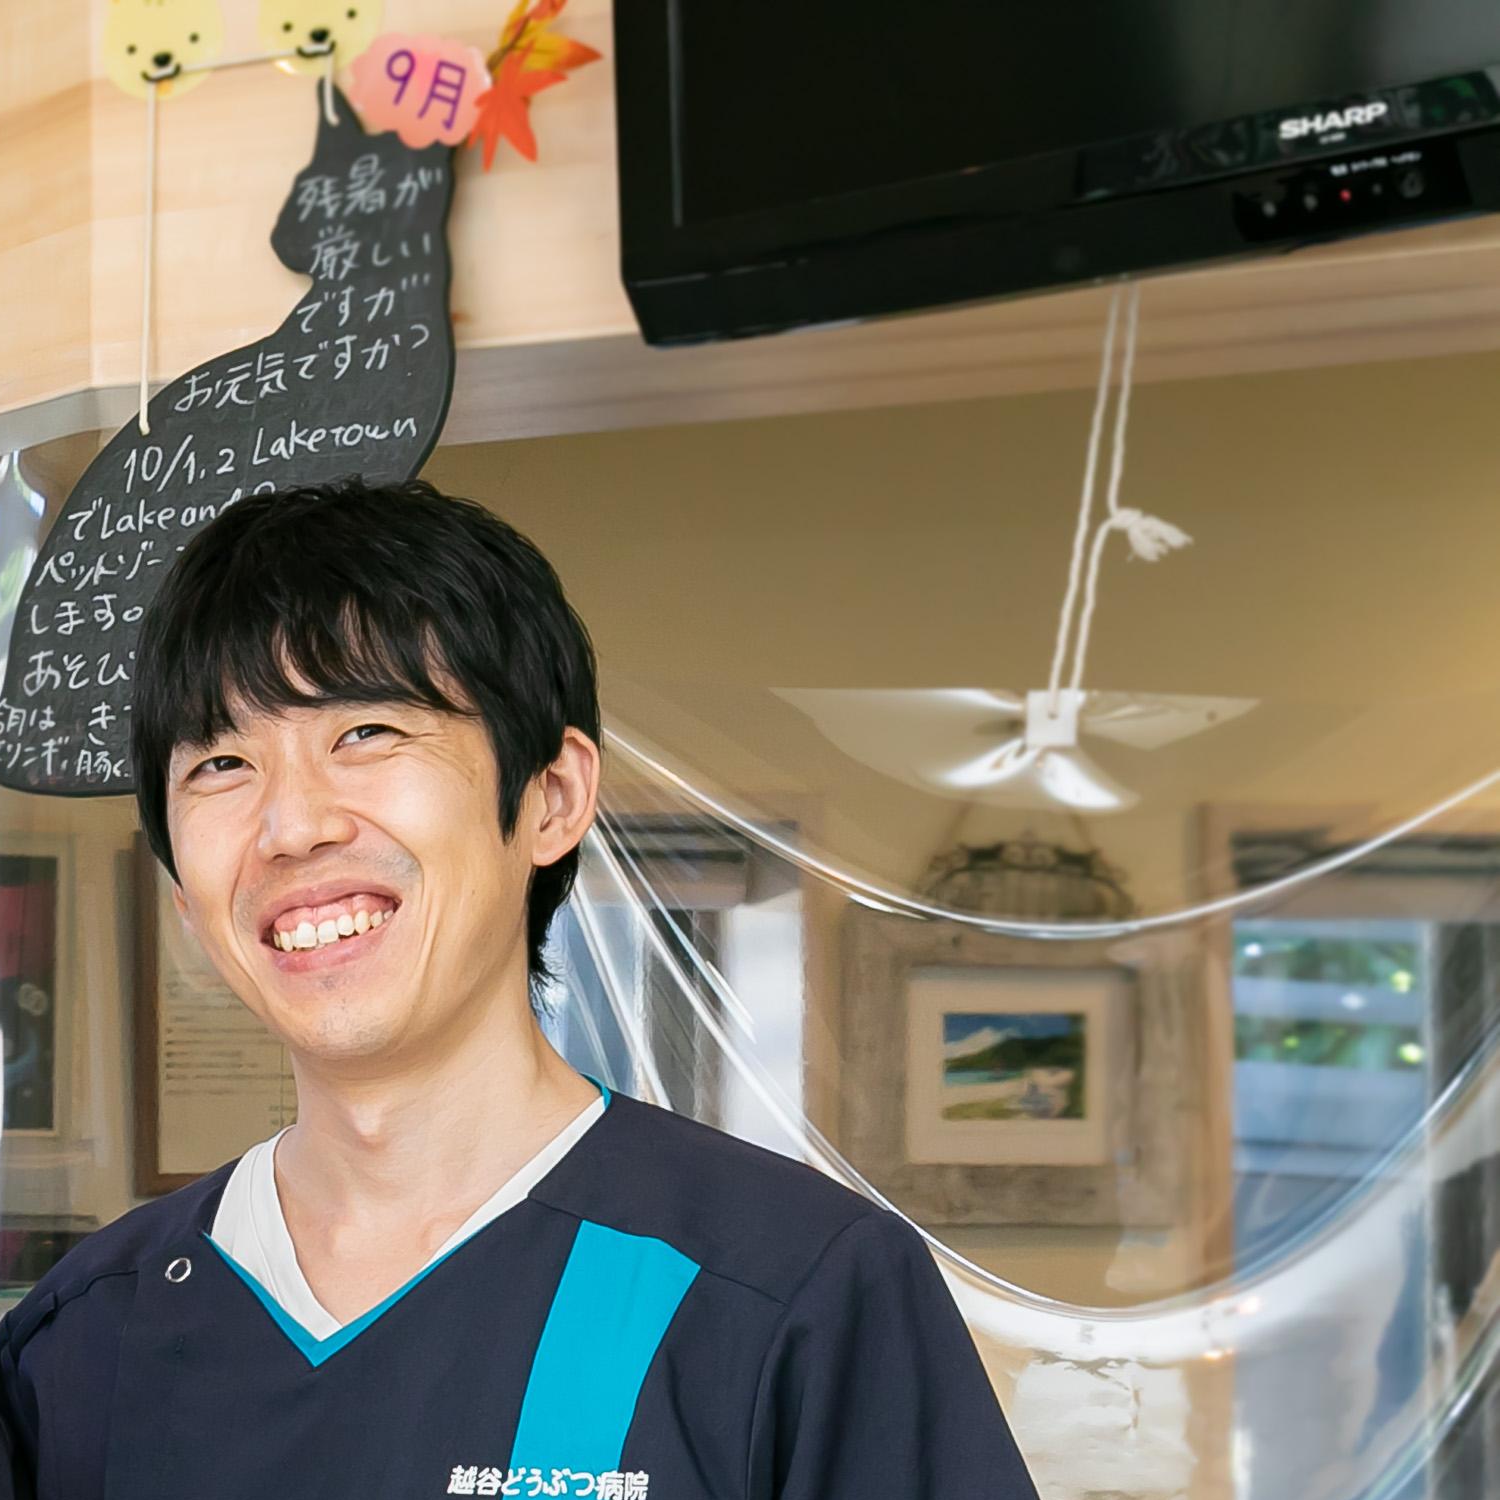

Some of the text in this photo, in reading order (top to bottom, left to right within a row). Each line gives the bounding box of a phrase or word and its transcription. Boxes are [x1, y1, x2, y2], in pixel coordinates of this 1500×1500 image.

[385, 49, 468, 131] 9月
[1279, 101, 1388, 139] SHARP
[297, 154, 443, 223] 残暑が
[310, 227, 432, 281] 厳しい
